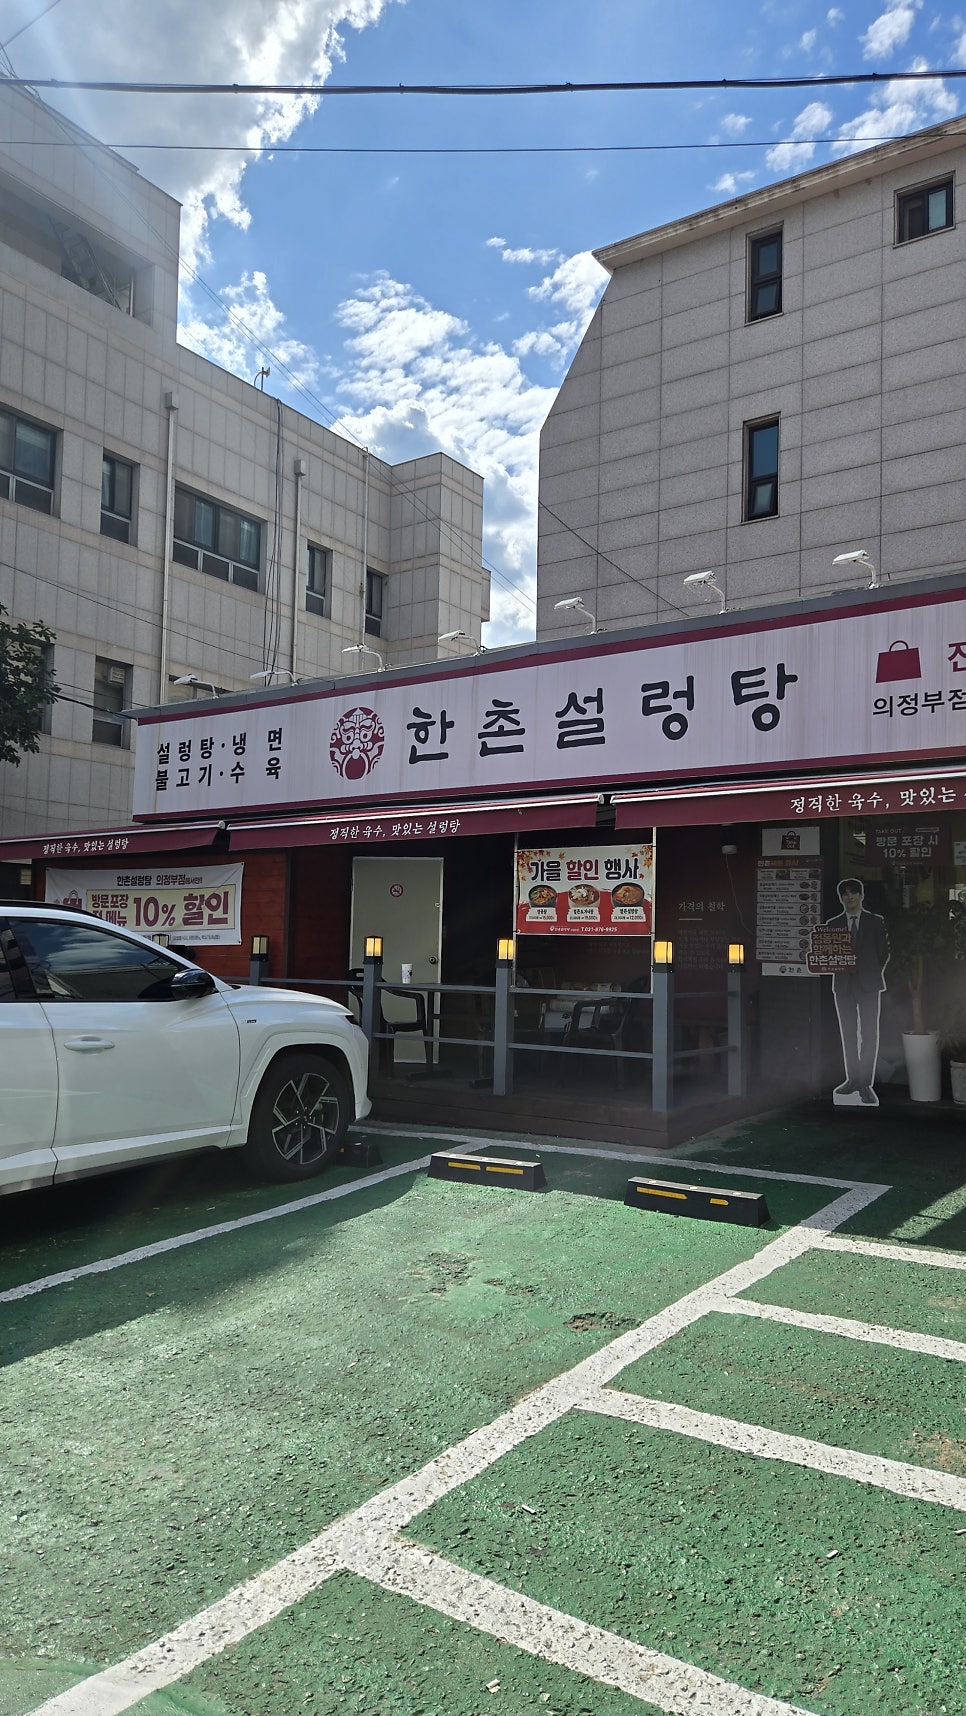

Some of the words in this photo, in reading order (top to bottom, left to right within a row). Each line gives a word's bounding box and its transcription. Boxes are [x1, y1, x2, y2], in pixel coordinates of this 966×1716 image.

[873, 689, 966, 717] 의정부점
[406, 663, 798, 764] 한촌설렁탕
[790, 793, 842, 814] 정직한
[900, 786, 957, 807] 맛있는
[330, 825, 360, 840] 정직한
[391, 822, 423, 836] 맛있는
[427, 819, 461, 834] 설렁탕
[83, 841, 105, 852] 맛있는
[107, 838, 129, 850] 설렁탕
[876, 836, 897, 846] 방문
[901, 835, 923, 846] 포장
[928, 834, 938, 845] 시
[883, 848, 906, 858] 10%
[909, 847, 932, 857] 할인
[530, 860, 561, 881] 가을
[566, 859, 599, 880] 할인
[604, 858, 640, 880] 행사
[117, 875, 152, 886] 한촌설렁탕
[133, 896, 177, 927] 10%
[182, 891, 230, 926] 할인
[678, 901, 704, 912] 가격의
[708, 901, 726, 912] 철학
[813, 933, 852, 944] 정동원과
[813, 944, 852, 955] 함께하는
[810, 955, 857, 966] 한촌설렁탕
